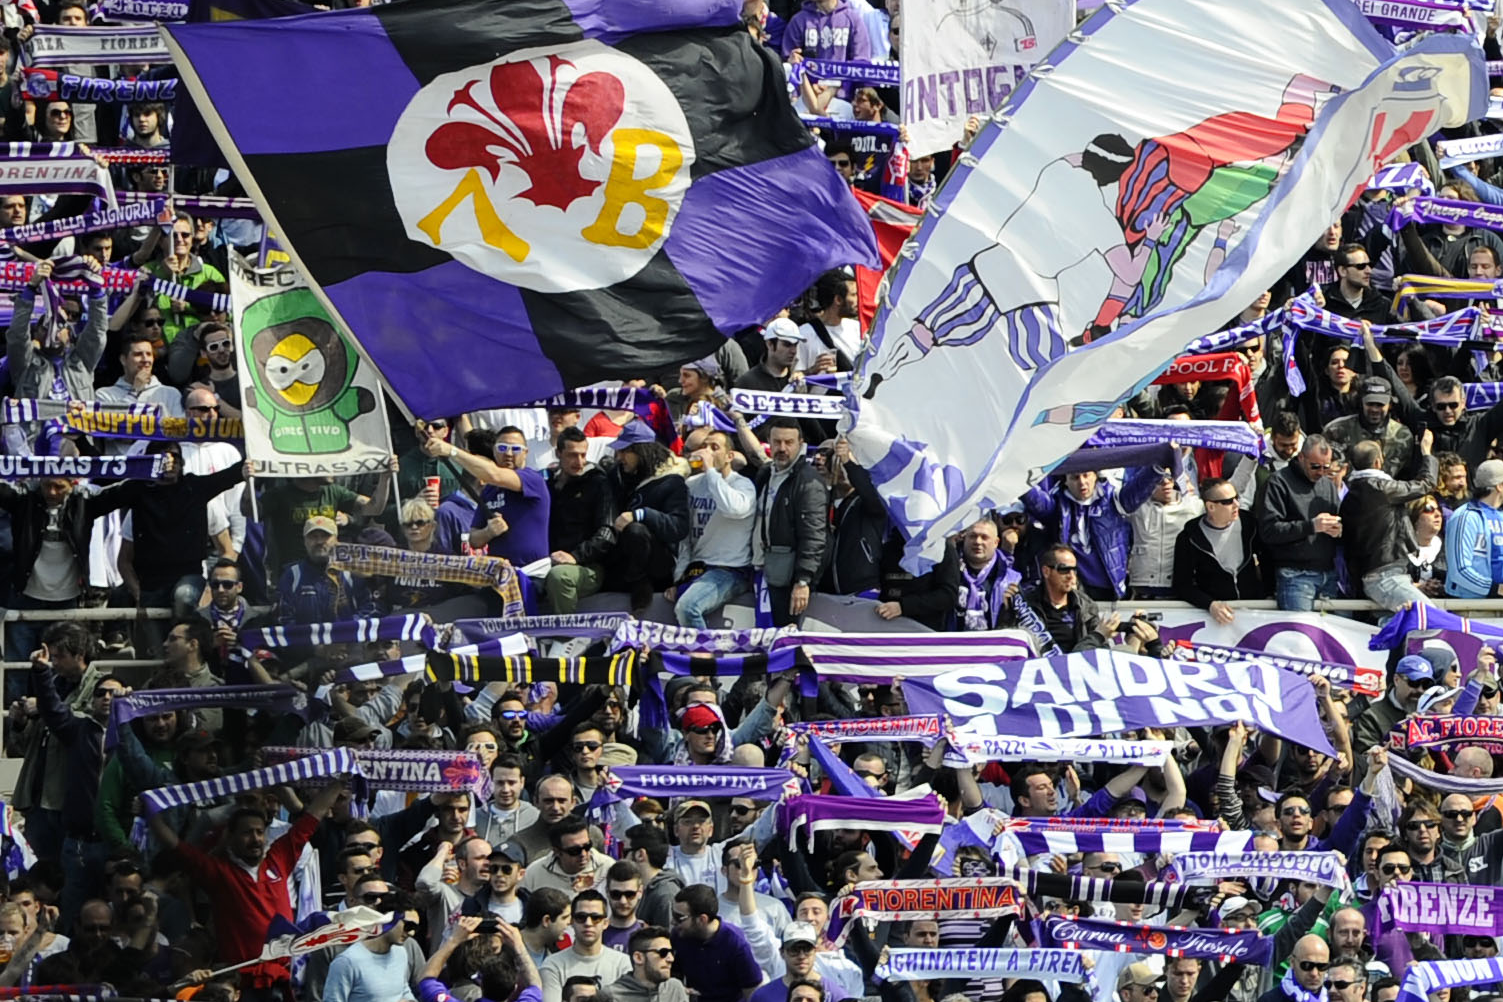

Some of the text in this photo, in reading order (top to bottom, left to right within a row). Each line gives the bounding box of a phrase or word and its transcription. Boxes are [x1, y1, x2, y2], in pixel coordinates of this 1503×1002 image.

[821, 64, 898, 80] FIORENT
[62, 77, 179, 99] FIRENZ
[101, 455, 126, 475] 73
[937, 652, 1284, 718] SANDRO
[640, 774, 766, 790] FIORENTINA
[863, 886, 1015, 910] FIORENTINA
[1380, 884, 1497, 926] FIRENZE
[1051, 919, 1126, 943] Curva
[1006, 952, 1019, 971] A
[1031, 952, 1084, 974] FIREN
